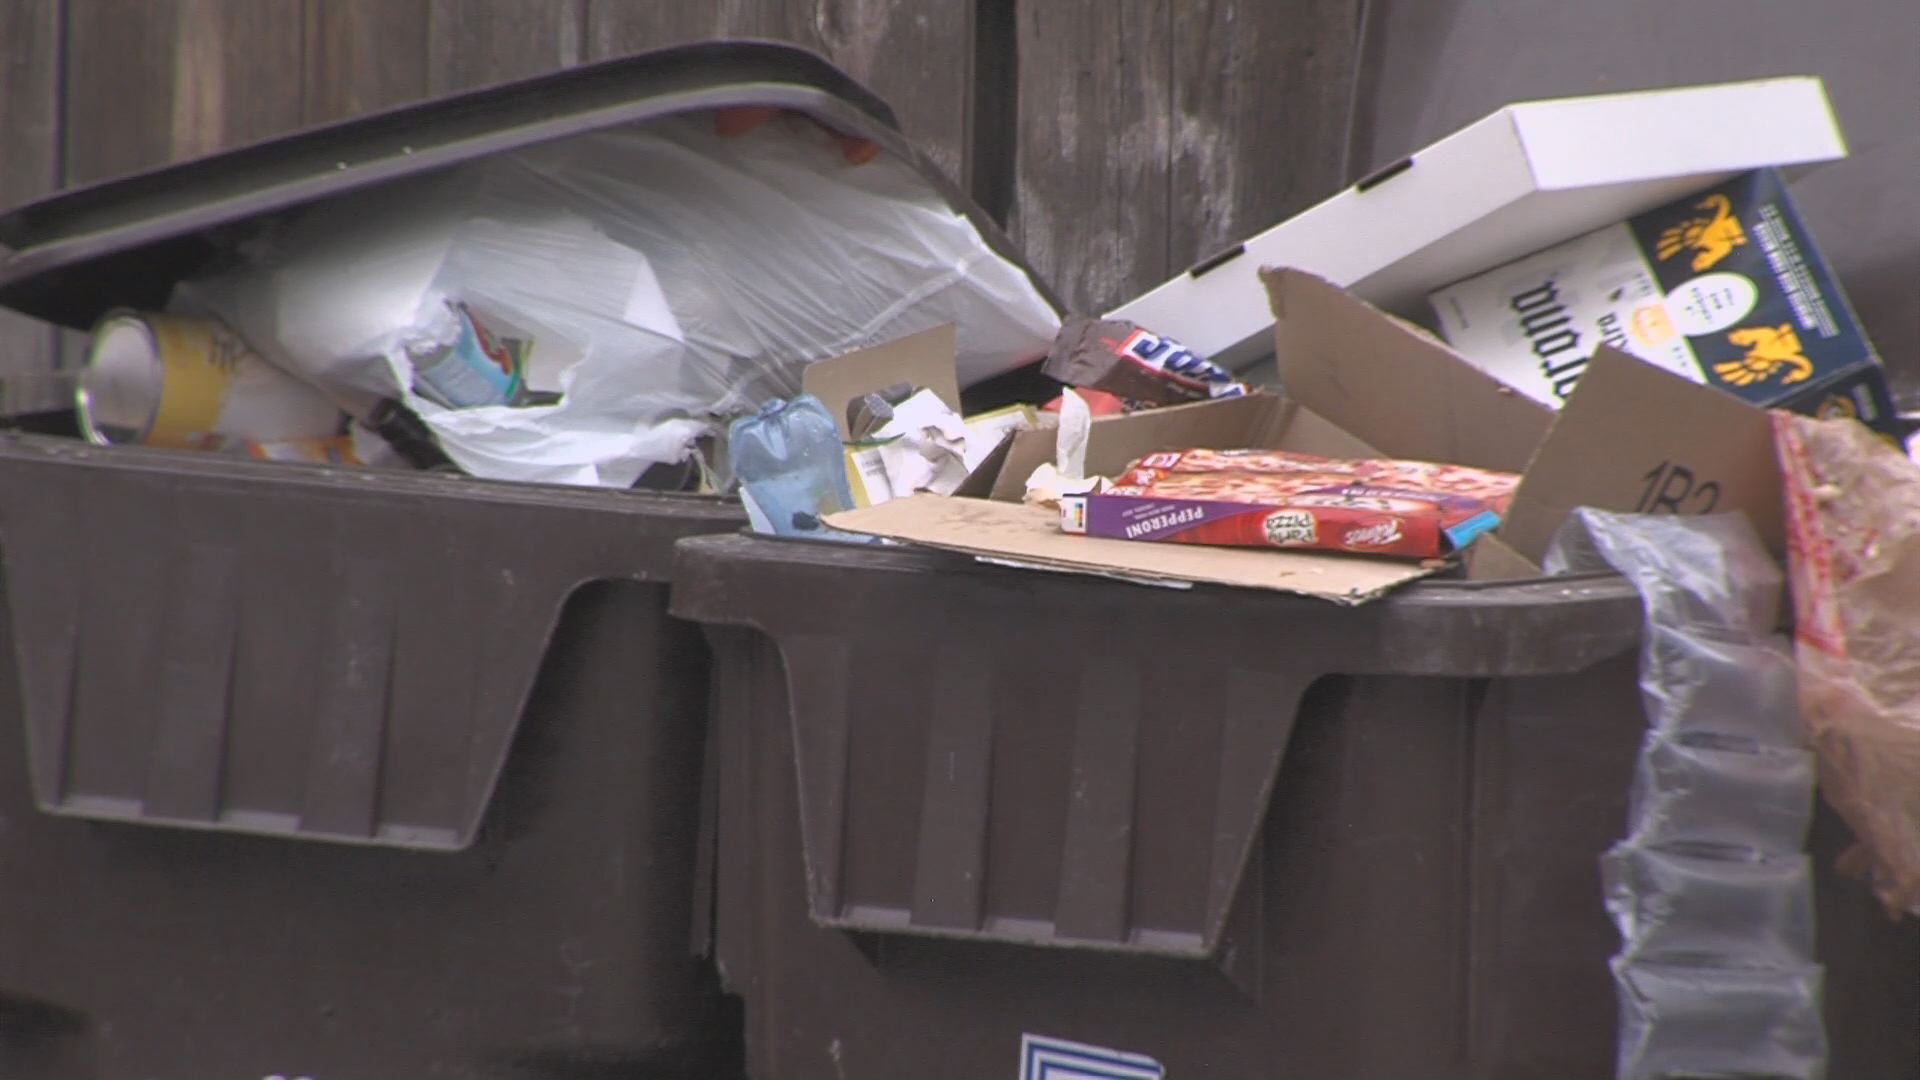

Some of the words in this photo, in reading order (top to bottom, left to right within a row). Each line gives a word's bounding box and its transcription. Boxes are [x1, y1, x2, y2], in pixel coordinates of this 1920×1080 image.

[1510, 280, 1590, 398] orona
[1125, 506, 1204, 539] PEPPERONI
[1266, 513, 1312, 530] Pizza
[1267, 528, 1314, 545] Party
